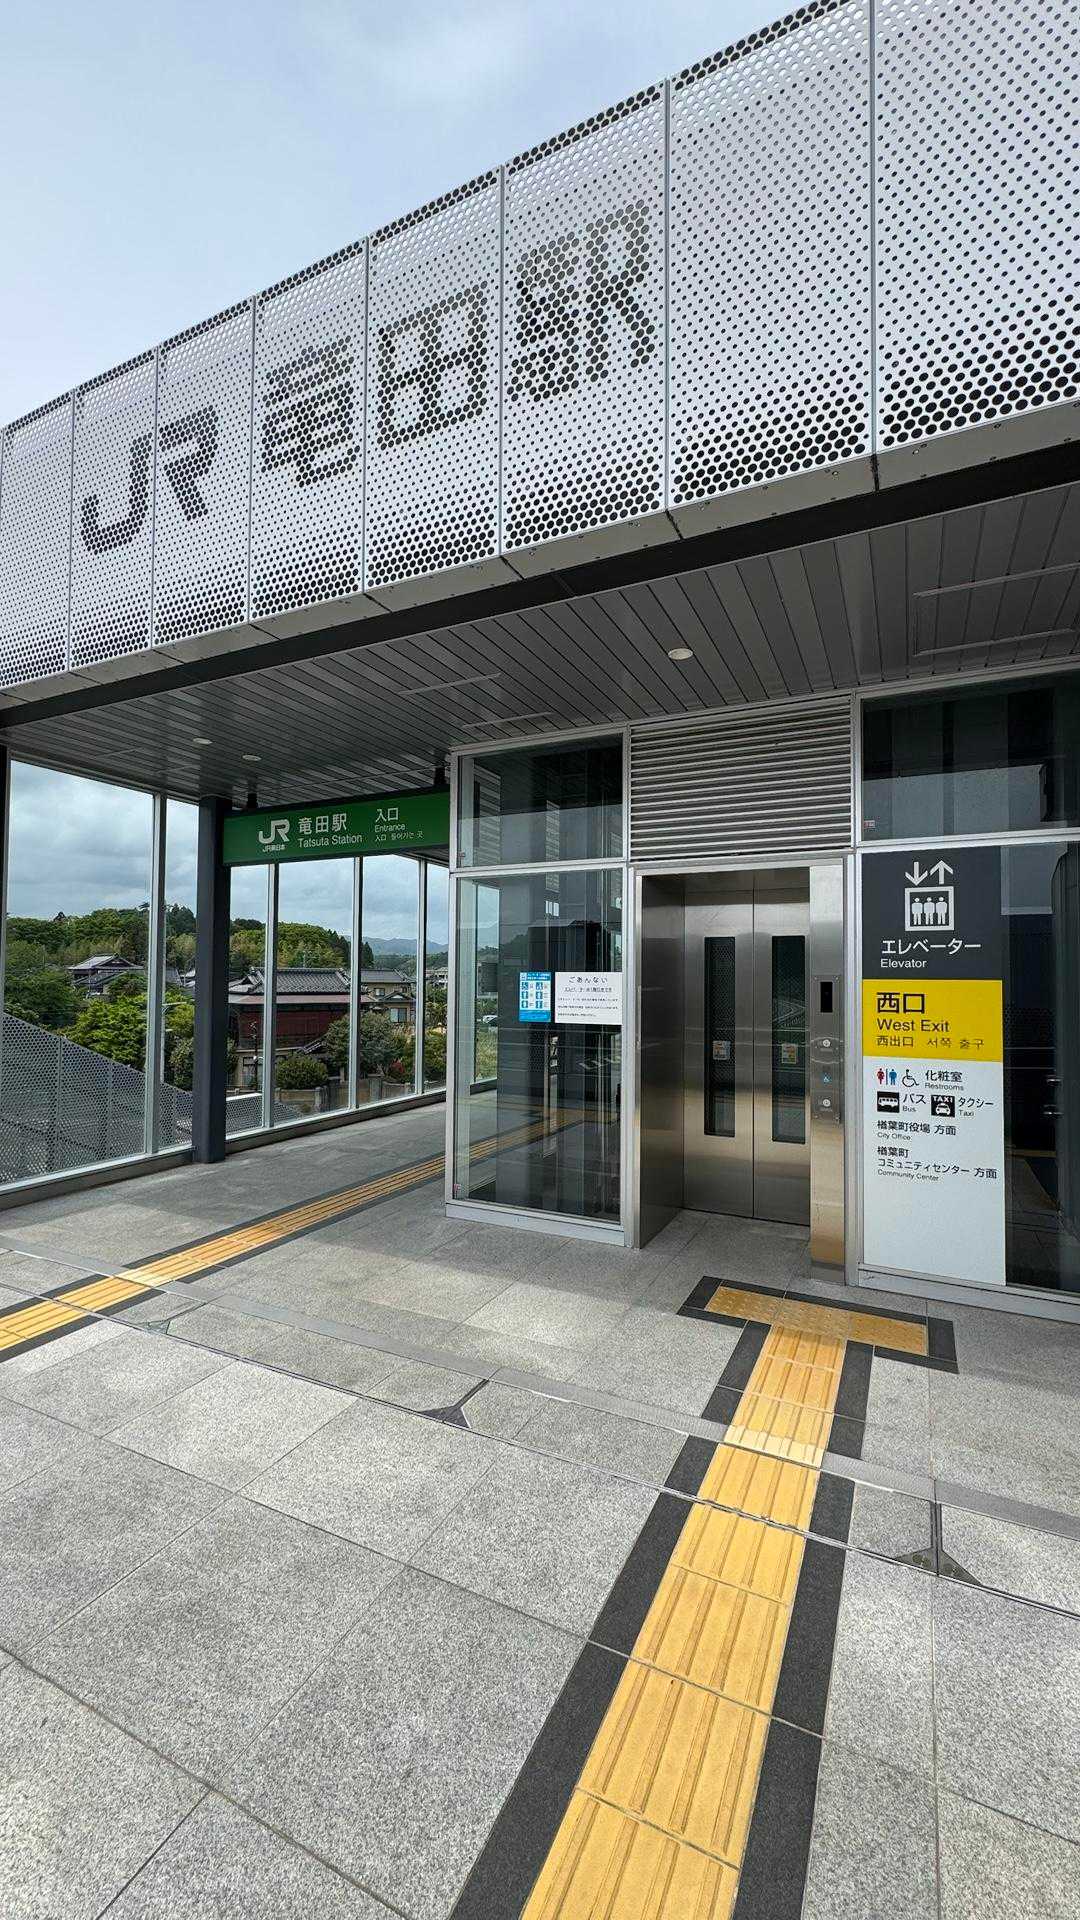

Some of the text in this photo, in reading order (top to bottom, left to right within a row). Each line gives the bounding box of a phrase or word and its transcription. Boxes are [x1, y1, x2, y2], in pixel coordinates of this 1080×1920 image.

[80, 199, 656, 555] JR 竜田駅
[375, 807, 399, 823] 入口
[298, 813, 347, 835] 竜田駅
[375, 823, 406, 834] Entrance
[258, 818, 291, 844] JR
[299, 833, 363, 849] Tatsuta Station
[881, 938, 982, 955] エレベーター
[880, 958, 928, 969] Elevator
[876, 992, 926, 1014] 西口
[877, 1018, 950, 1033] West Exit
[877, 1035, 914, 1048] 西出口
[927, 1036, 952, 1049] 서쪽
[925, 1070, 963, 1083] 化粧室
[924, 1082, 965, 1092] Restrooms
[902, 1093, 927, 1105] バス
[932, 1095, 954, 1103] TAXI
[958, 1097, 994, 1109] タクシー
[959, 1109, 975, 1117] Taxi
[877, 1132, 911, 1141] City Office
[934, 1125, 957, 1136] 方面
[877, 1169, 940, 1181] Community Center
[878, 1158, 998, 1179] コミュニティセンター 方面
